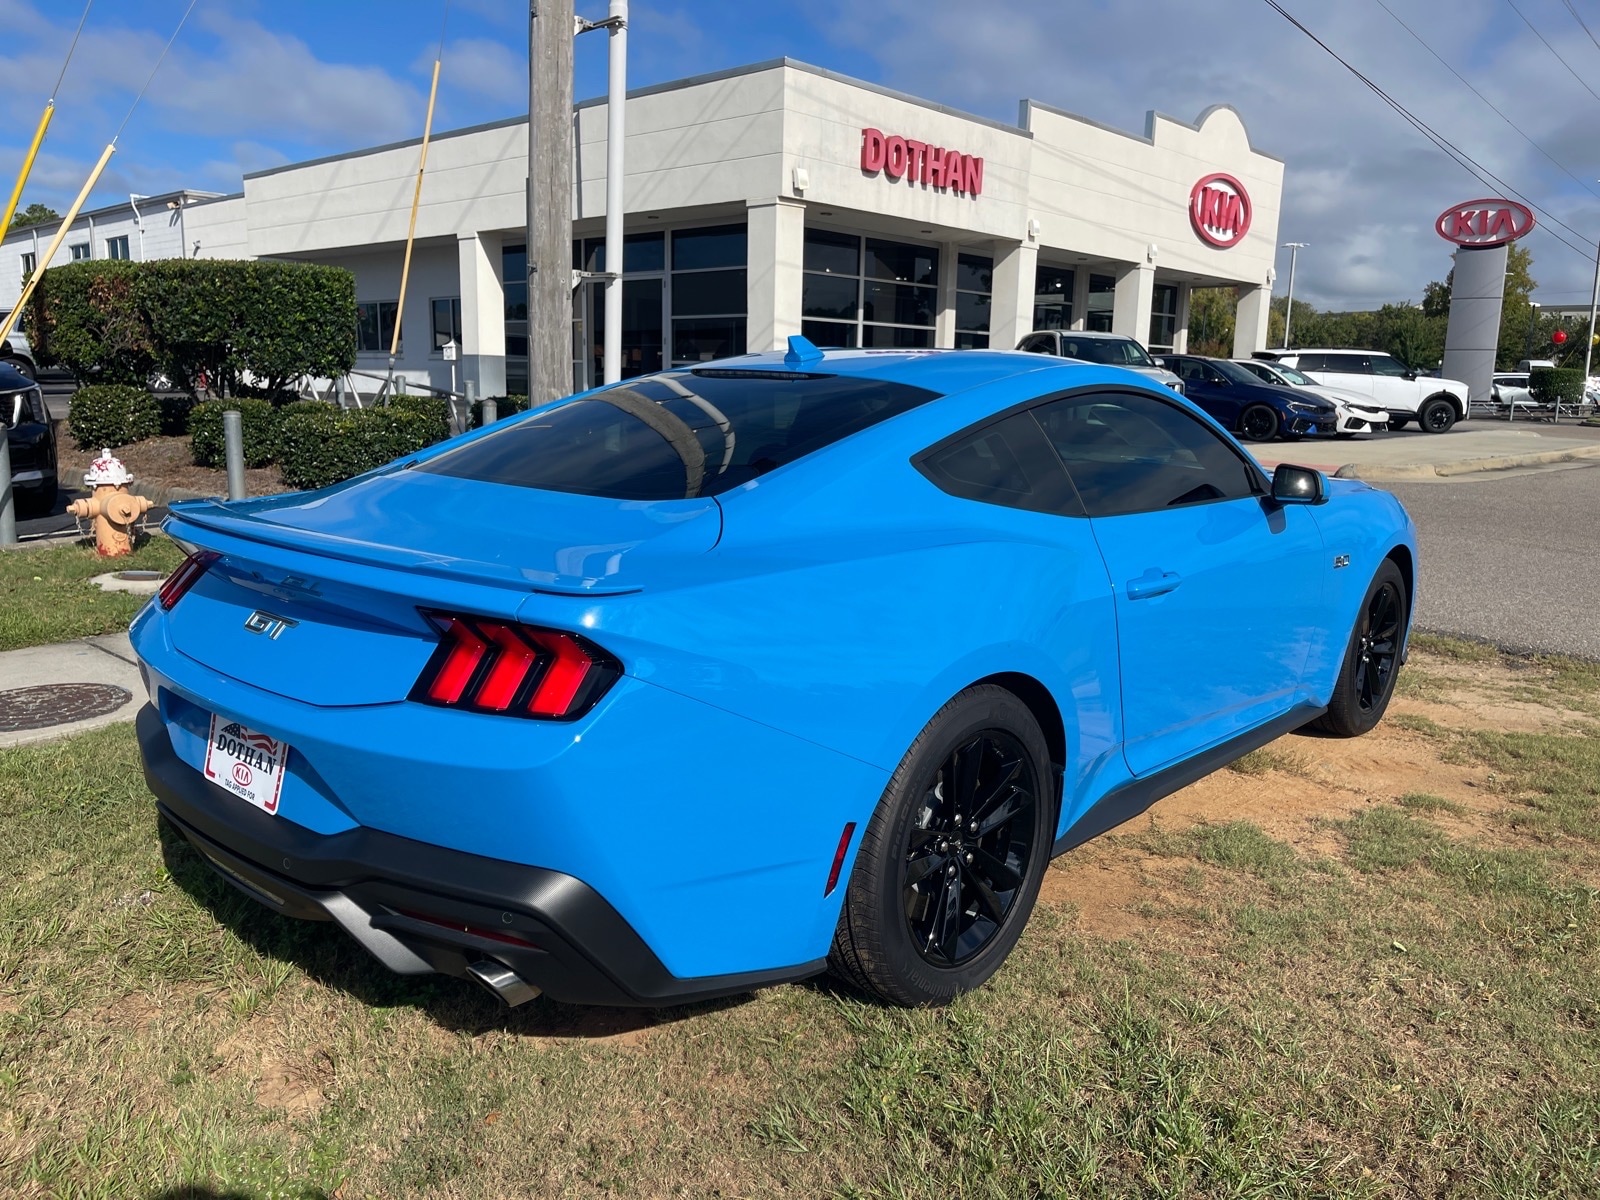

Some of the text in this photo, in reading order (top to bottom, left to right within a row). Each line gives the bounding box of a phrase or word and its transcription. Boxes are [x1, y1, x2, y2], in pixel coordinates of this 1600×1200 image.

[861, 128, 983, 195] DOTHAN
[1201, 187, 1241, 235] KIA
[1451, 208, 1516, 237] KIA
[245, 609, 300, 641] GT
[216, 734, 277, 775] DOTHAN
[235, 765, 249, 784] KIA
[247, 790, 256, 801] FOR
